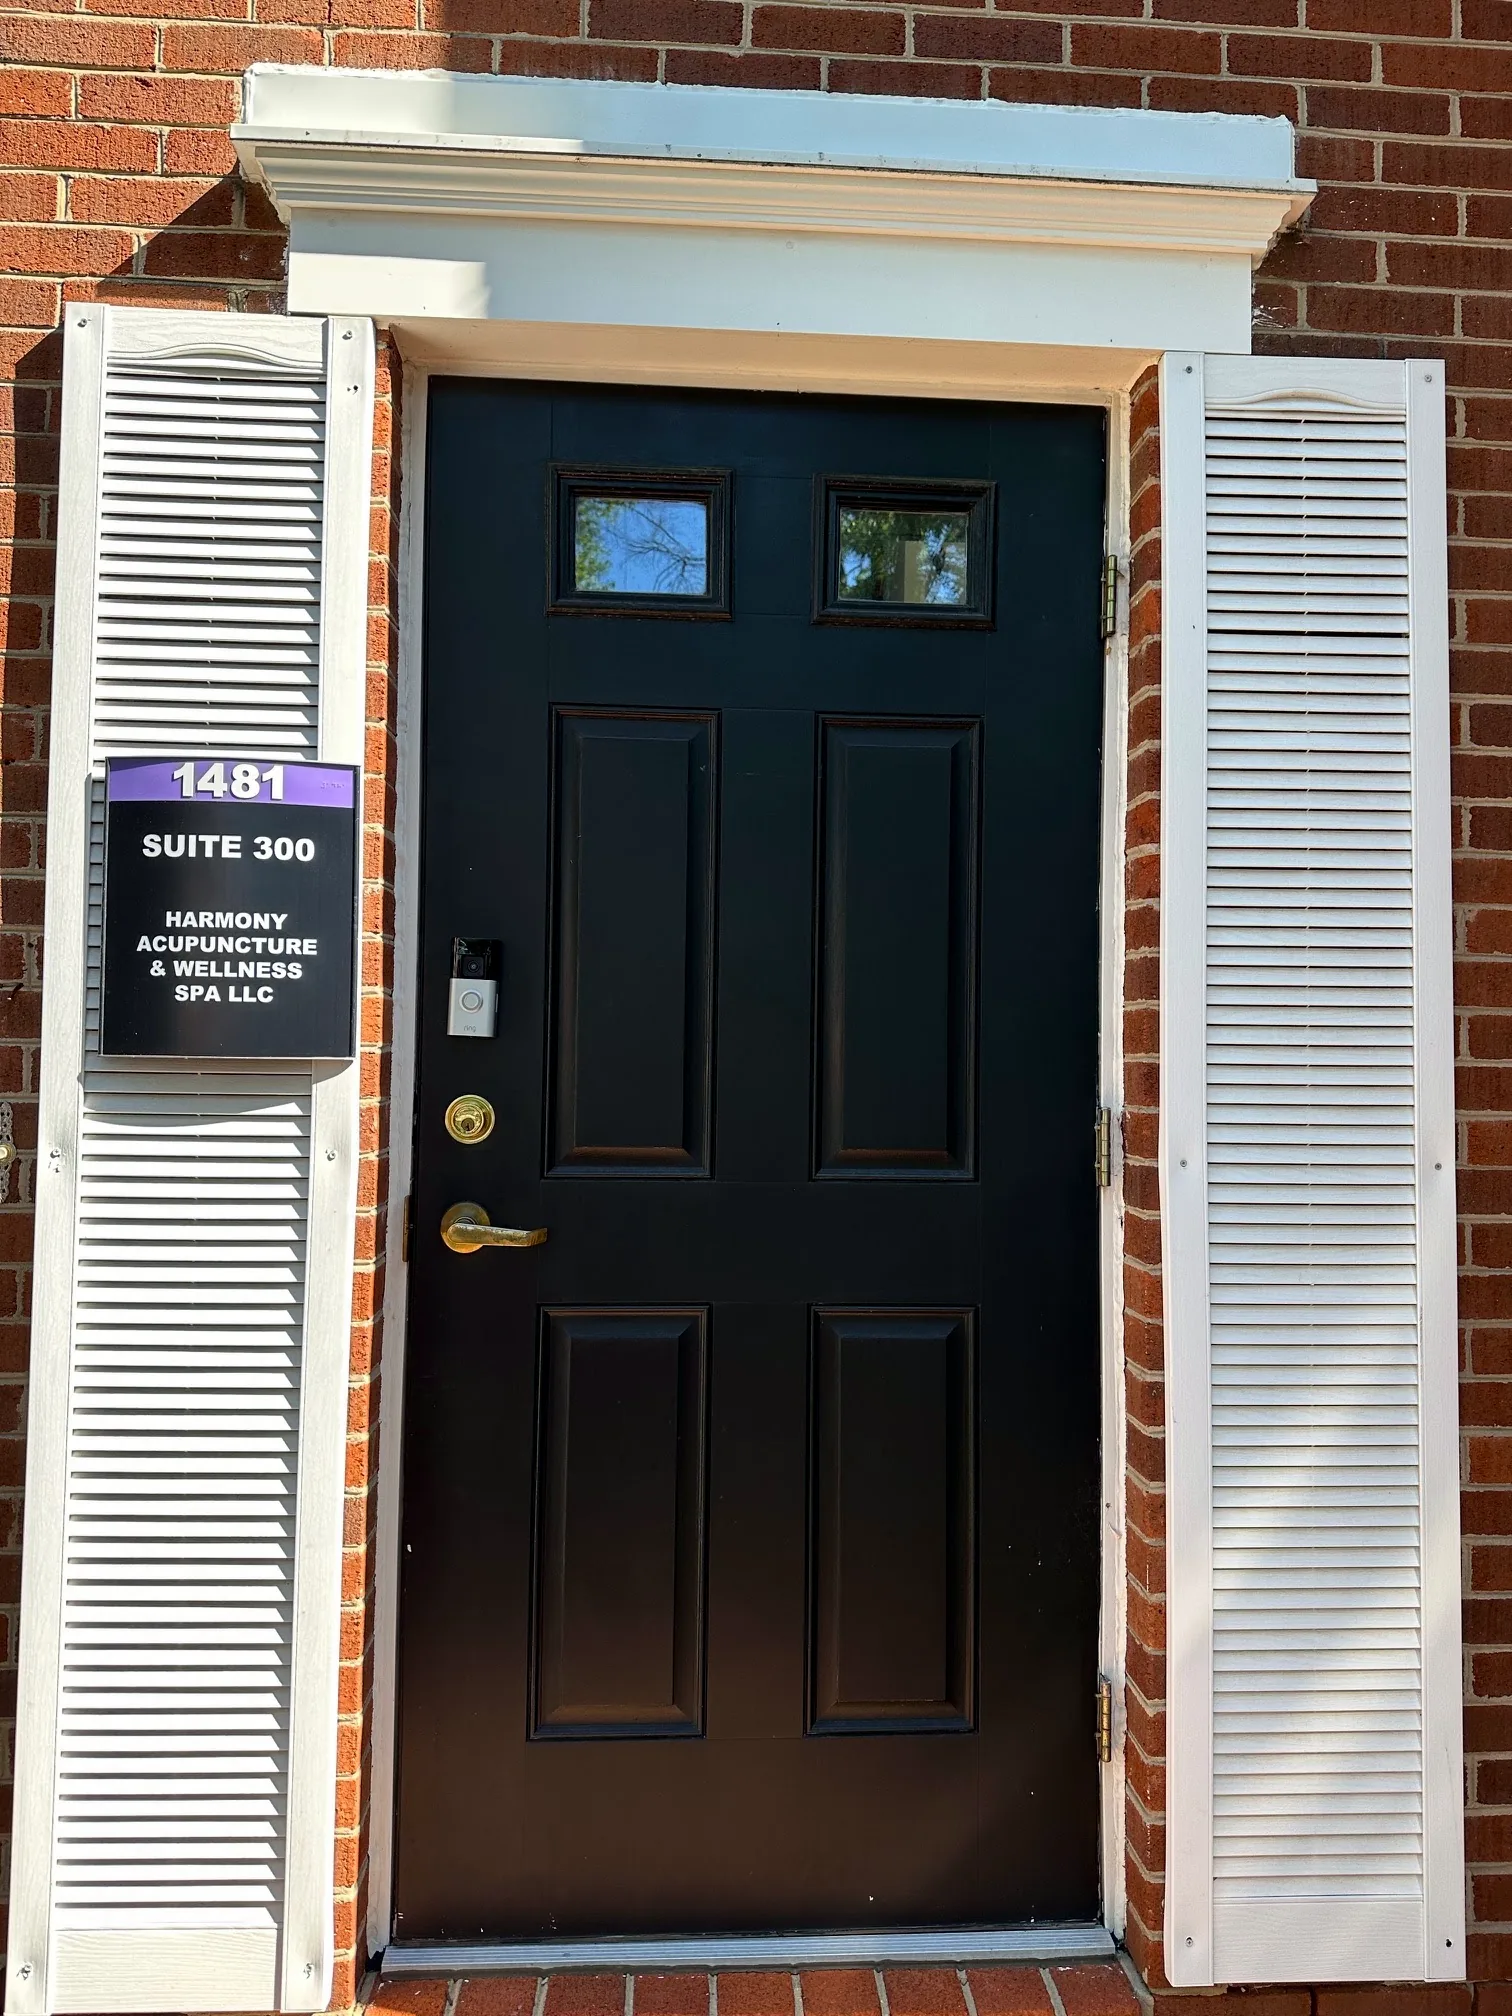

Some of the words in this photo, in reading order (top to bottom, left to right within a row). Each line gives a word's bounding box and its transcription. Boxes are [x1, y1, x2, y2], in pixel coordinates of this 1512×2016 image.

[171, 762, 284, 800] 1481
[142, 834, 242, 859] SUITE
[252, 836, 315, 862] 300
[165, 911, 288, 930] HARMONY
[136, 935, 318, 956] ACUPUNCTURE
[149, 960, 166, 977] &
[173, 960, 302, 979] WELLNESS
[174, 985, 221, 1002] SPA
[228, 986, 274, 1003] LLC
[463, 1024, 477, 1033] ring
